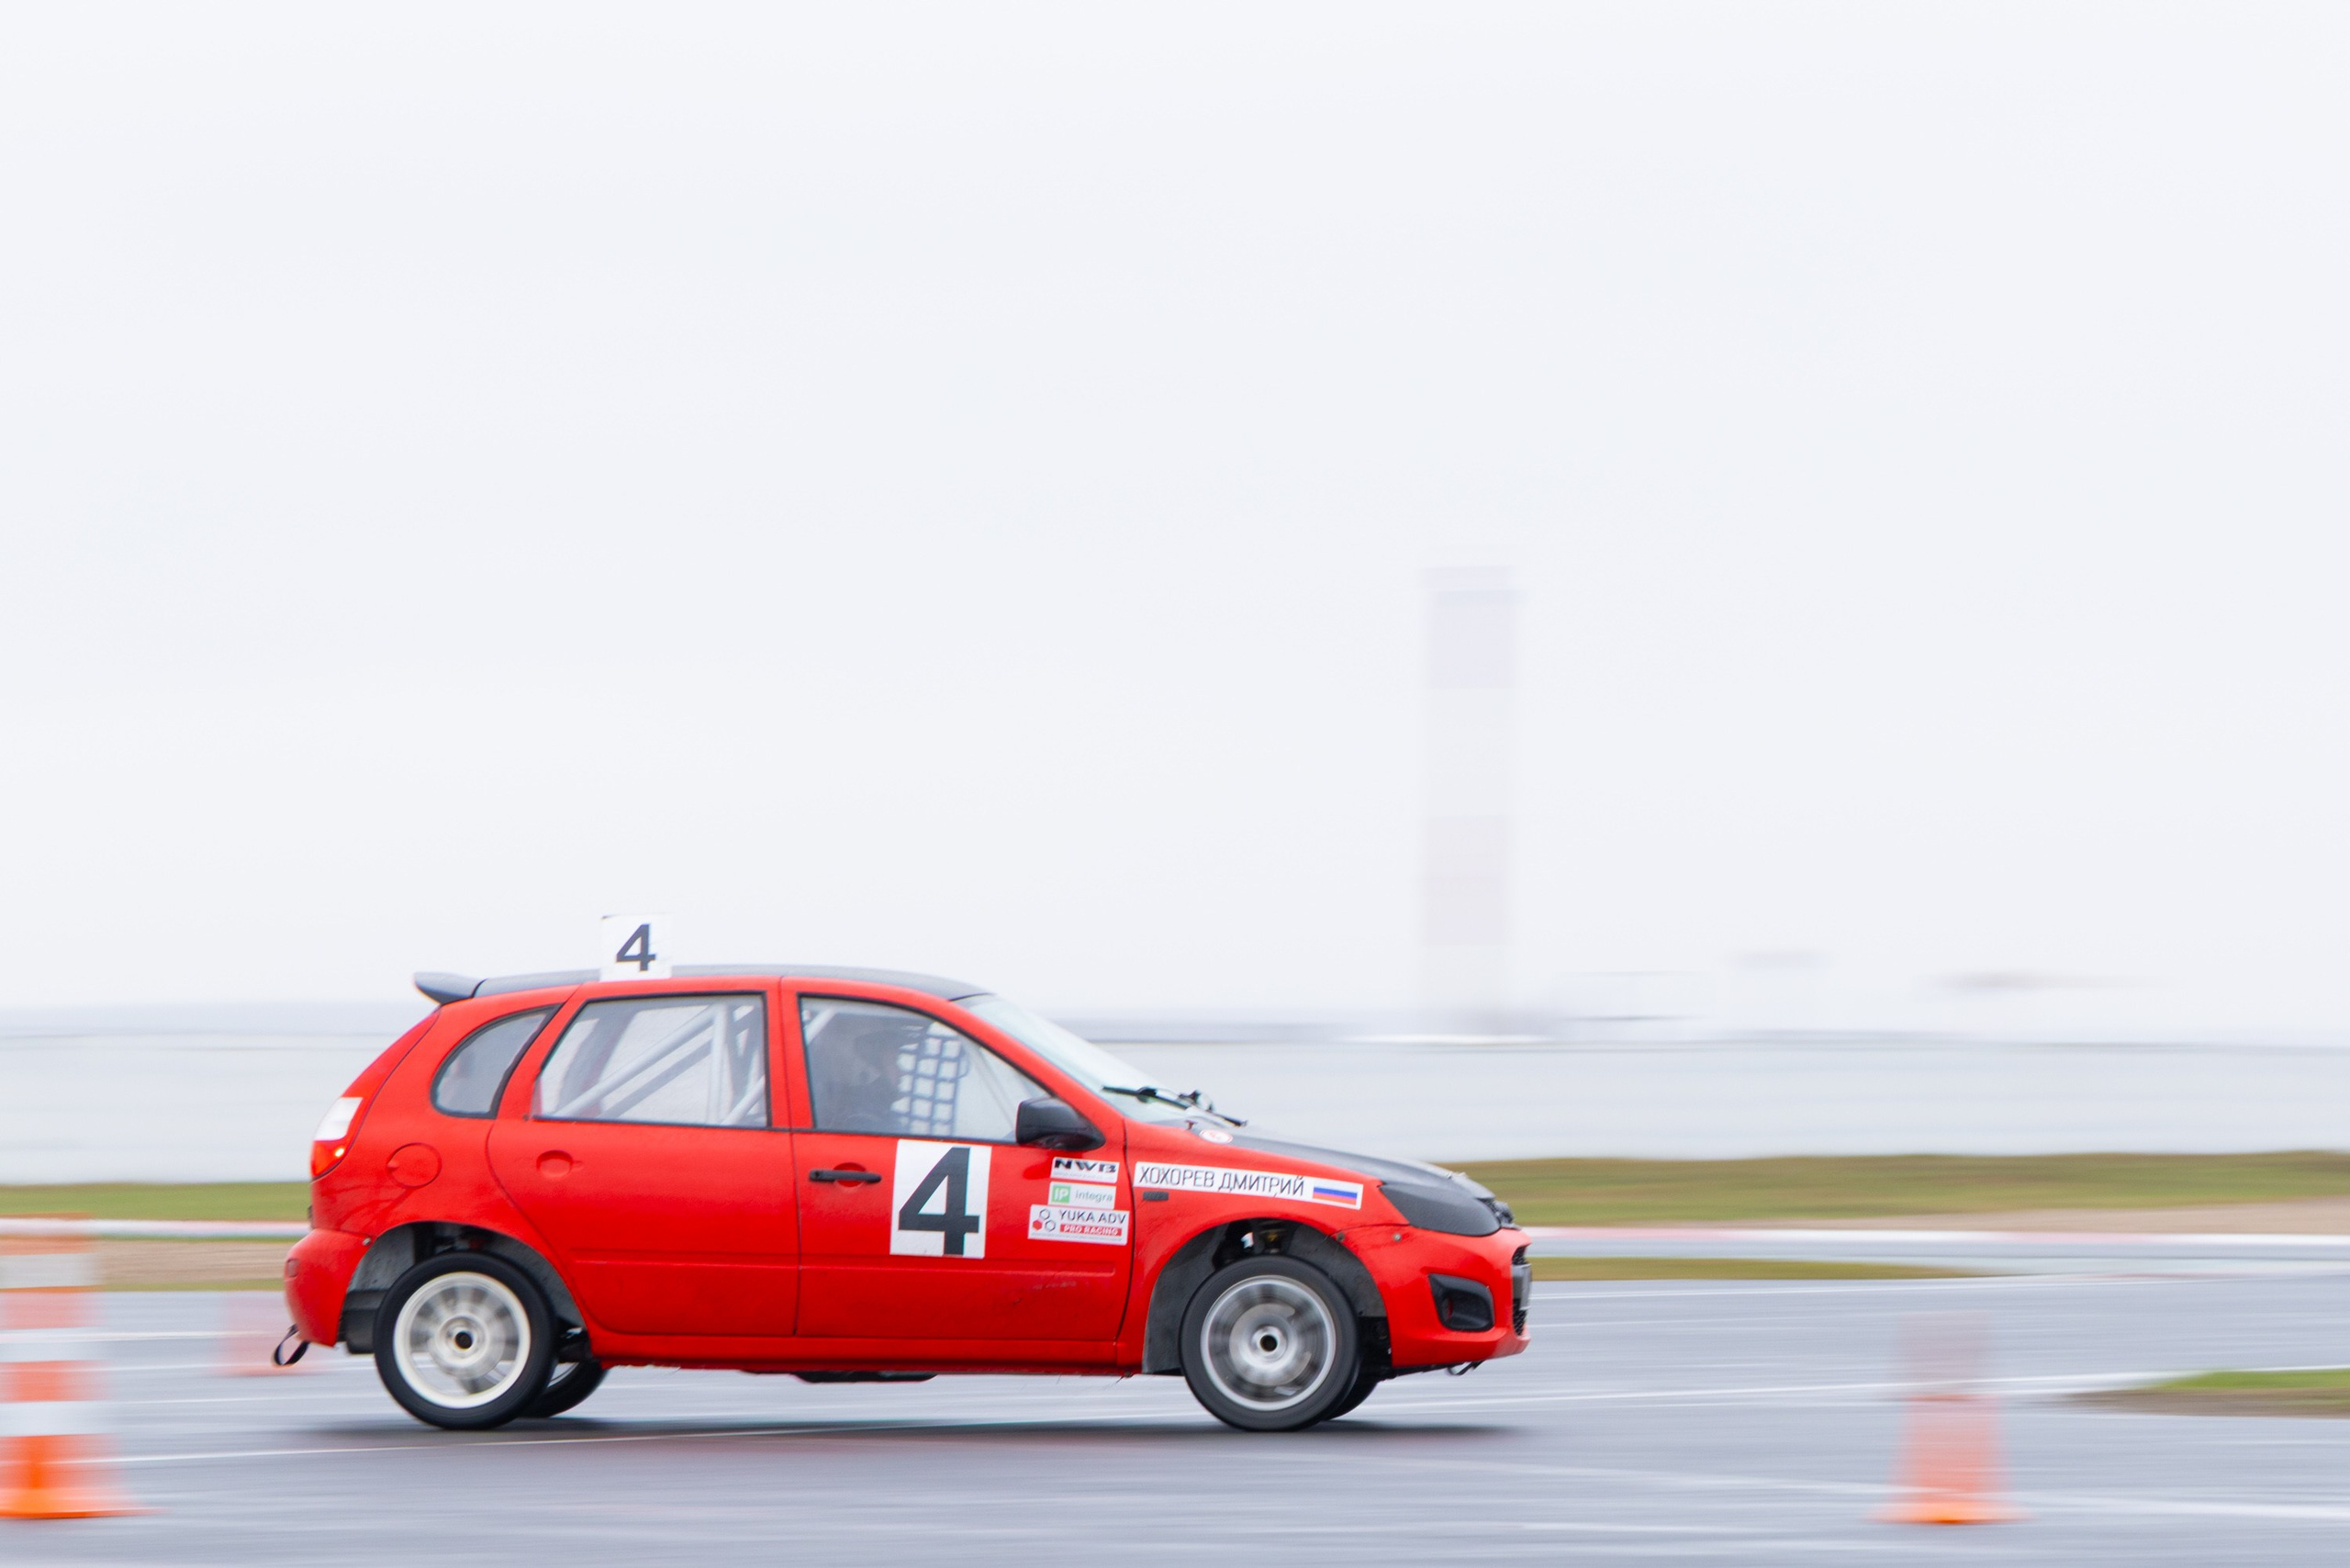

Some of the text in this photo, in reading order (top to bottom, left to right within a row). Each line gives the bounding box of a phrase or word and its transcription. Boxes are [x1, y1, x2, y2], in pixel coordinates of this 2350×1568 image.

[616, 924, 656, 971] 4
[1055, 1159, 1116, 1172] NWB
[1138, 1165, 1305, 1197] ХОХОРЕВ ДМИТРИЙ
[899, 1147, 979, 1255] 4
[1075, 1190, 1113, 1204] integra
[1059, 1209, 1126, 1225] YUKA ADV
[1084, 1226, 1119, 1236] RACING
